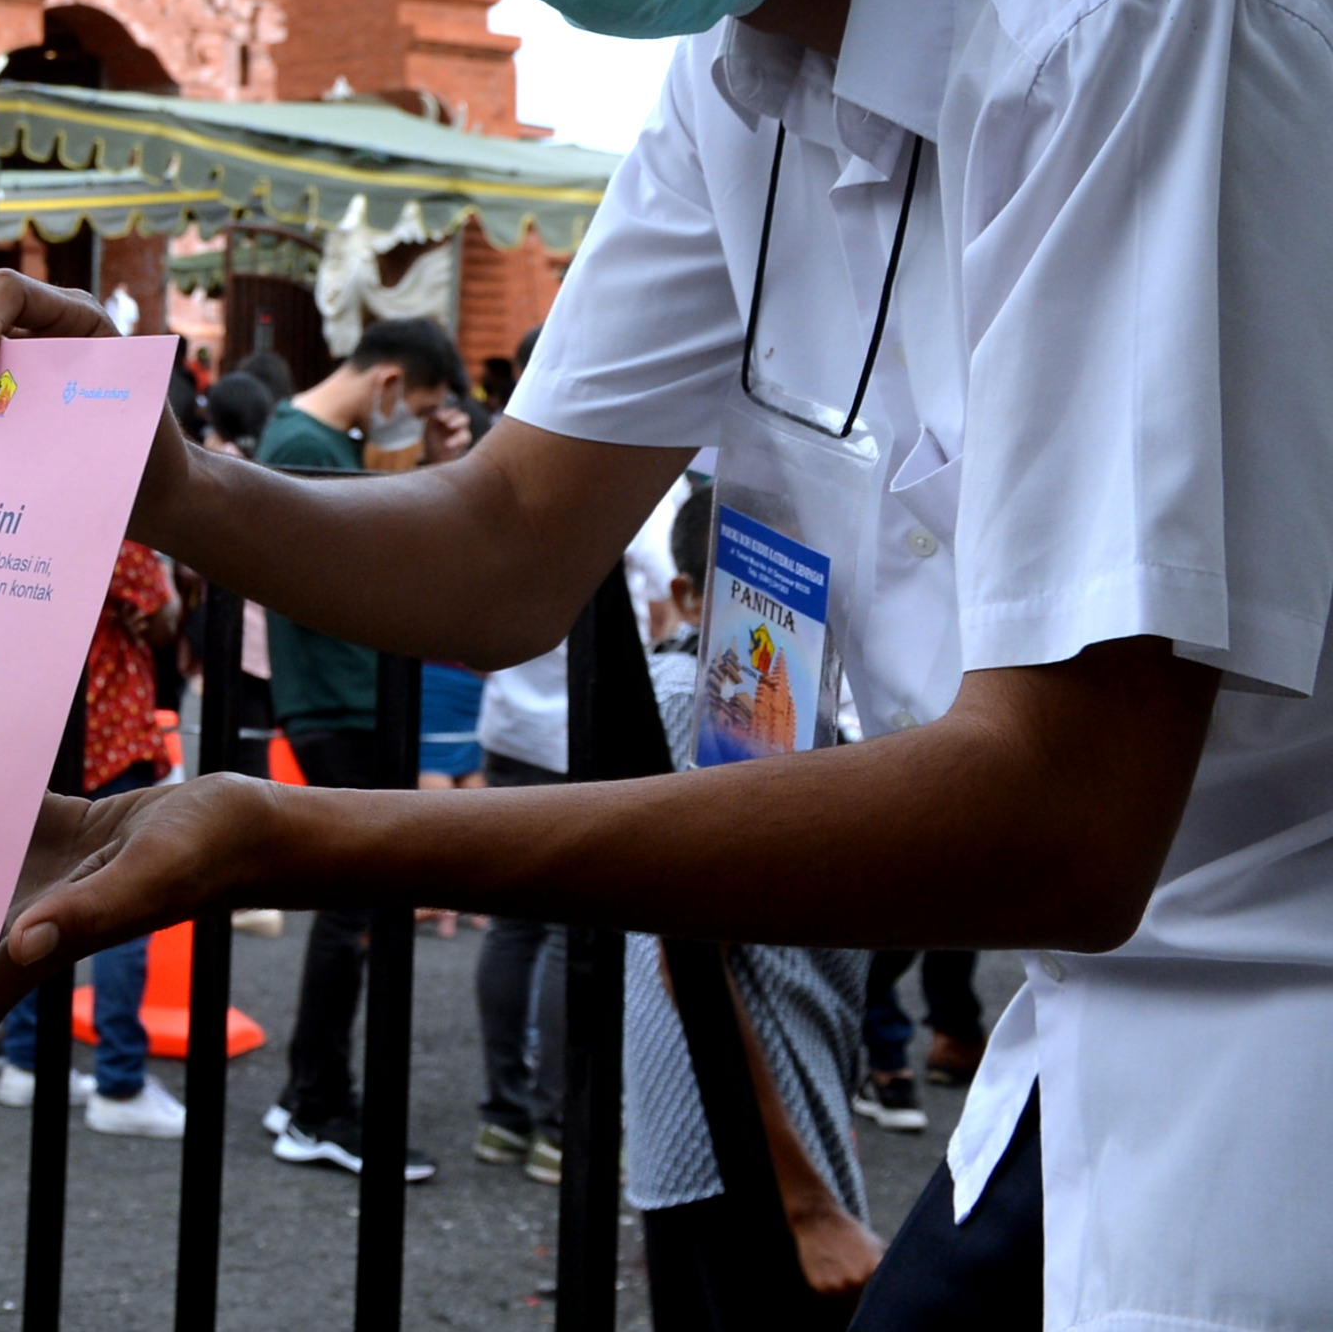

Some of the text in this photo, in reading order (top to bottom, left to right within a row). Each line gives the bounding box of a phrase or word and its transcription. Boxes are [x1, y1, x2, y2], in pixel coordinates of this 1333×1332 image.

[33, 556, 52, 577] ini,
[9, 579, 54, 601] kontak
[730, 579, 796, 634] PANITIA
